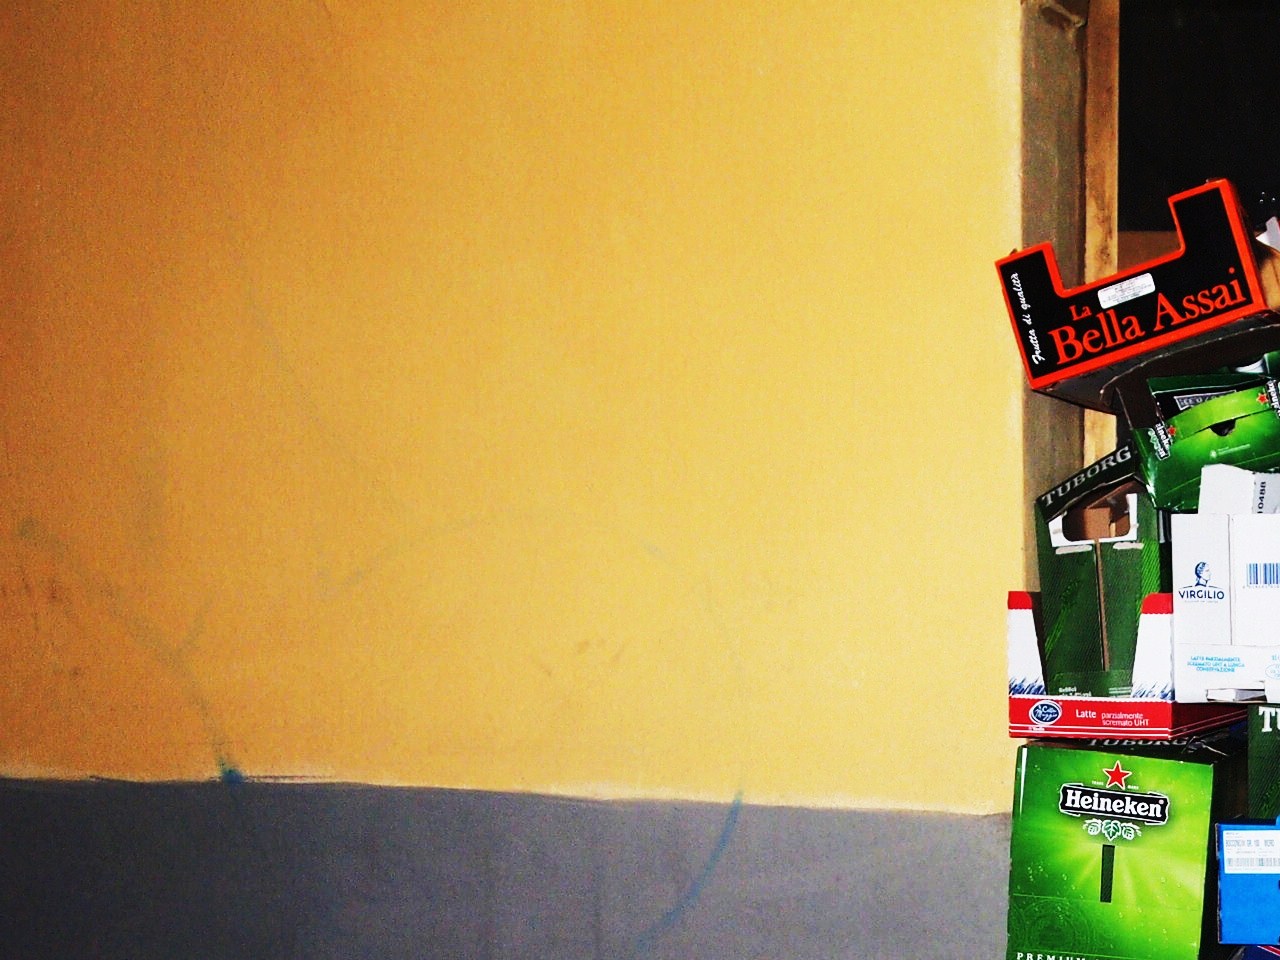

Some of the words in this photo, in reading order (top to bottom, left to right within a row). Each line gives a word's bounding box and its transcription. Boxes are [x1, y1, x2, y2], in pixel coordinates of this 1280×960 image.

[1011, 272, 1028, 310] qualità
[1022, 315, 1031, 326] di
[1048, 311, 1144, 365] Bella
[1154, 267, 1247, 332] Assai
[1069, 304, 1092, 321] La
[1032, 329, 1045, 364] Frutta
[1041, 446, 1133, 507] TUBORG
[1178, 590, 1225, 600] VIRGILIO
[1076, 709, 1096, 718] Latte
[1101, 712, 1143, 720] parzialmente
[1133, 719, 1149, 727] UHT
[1065, 789, 1163, 818] Heineken
